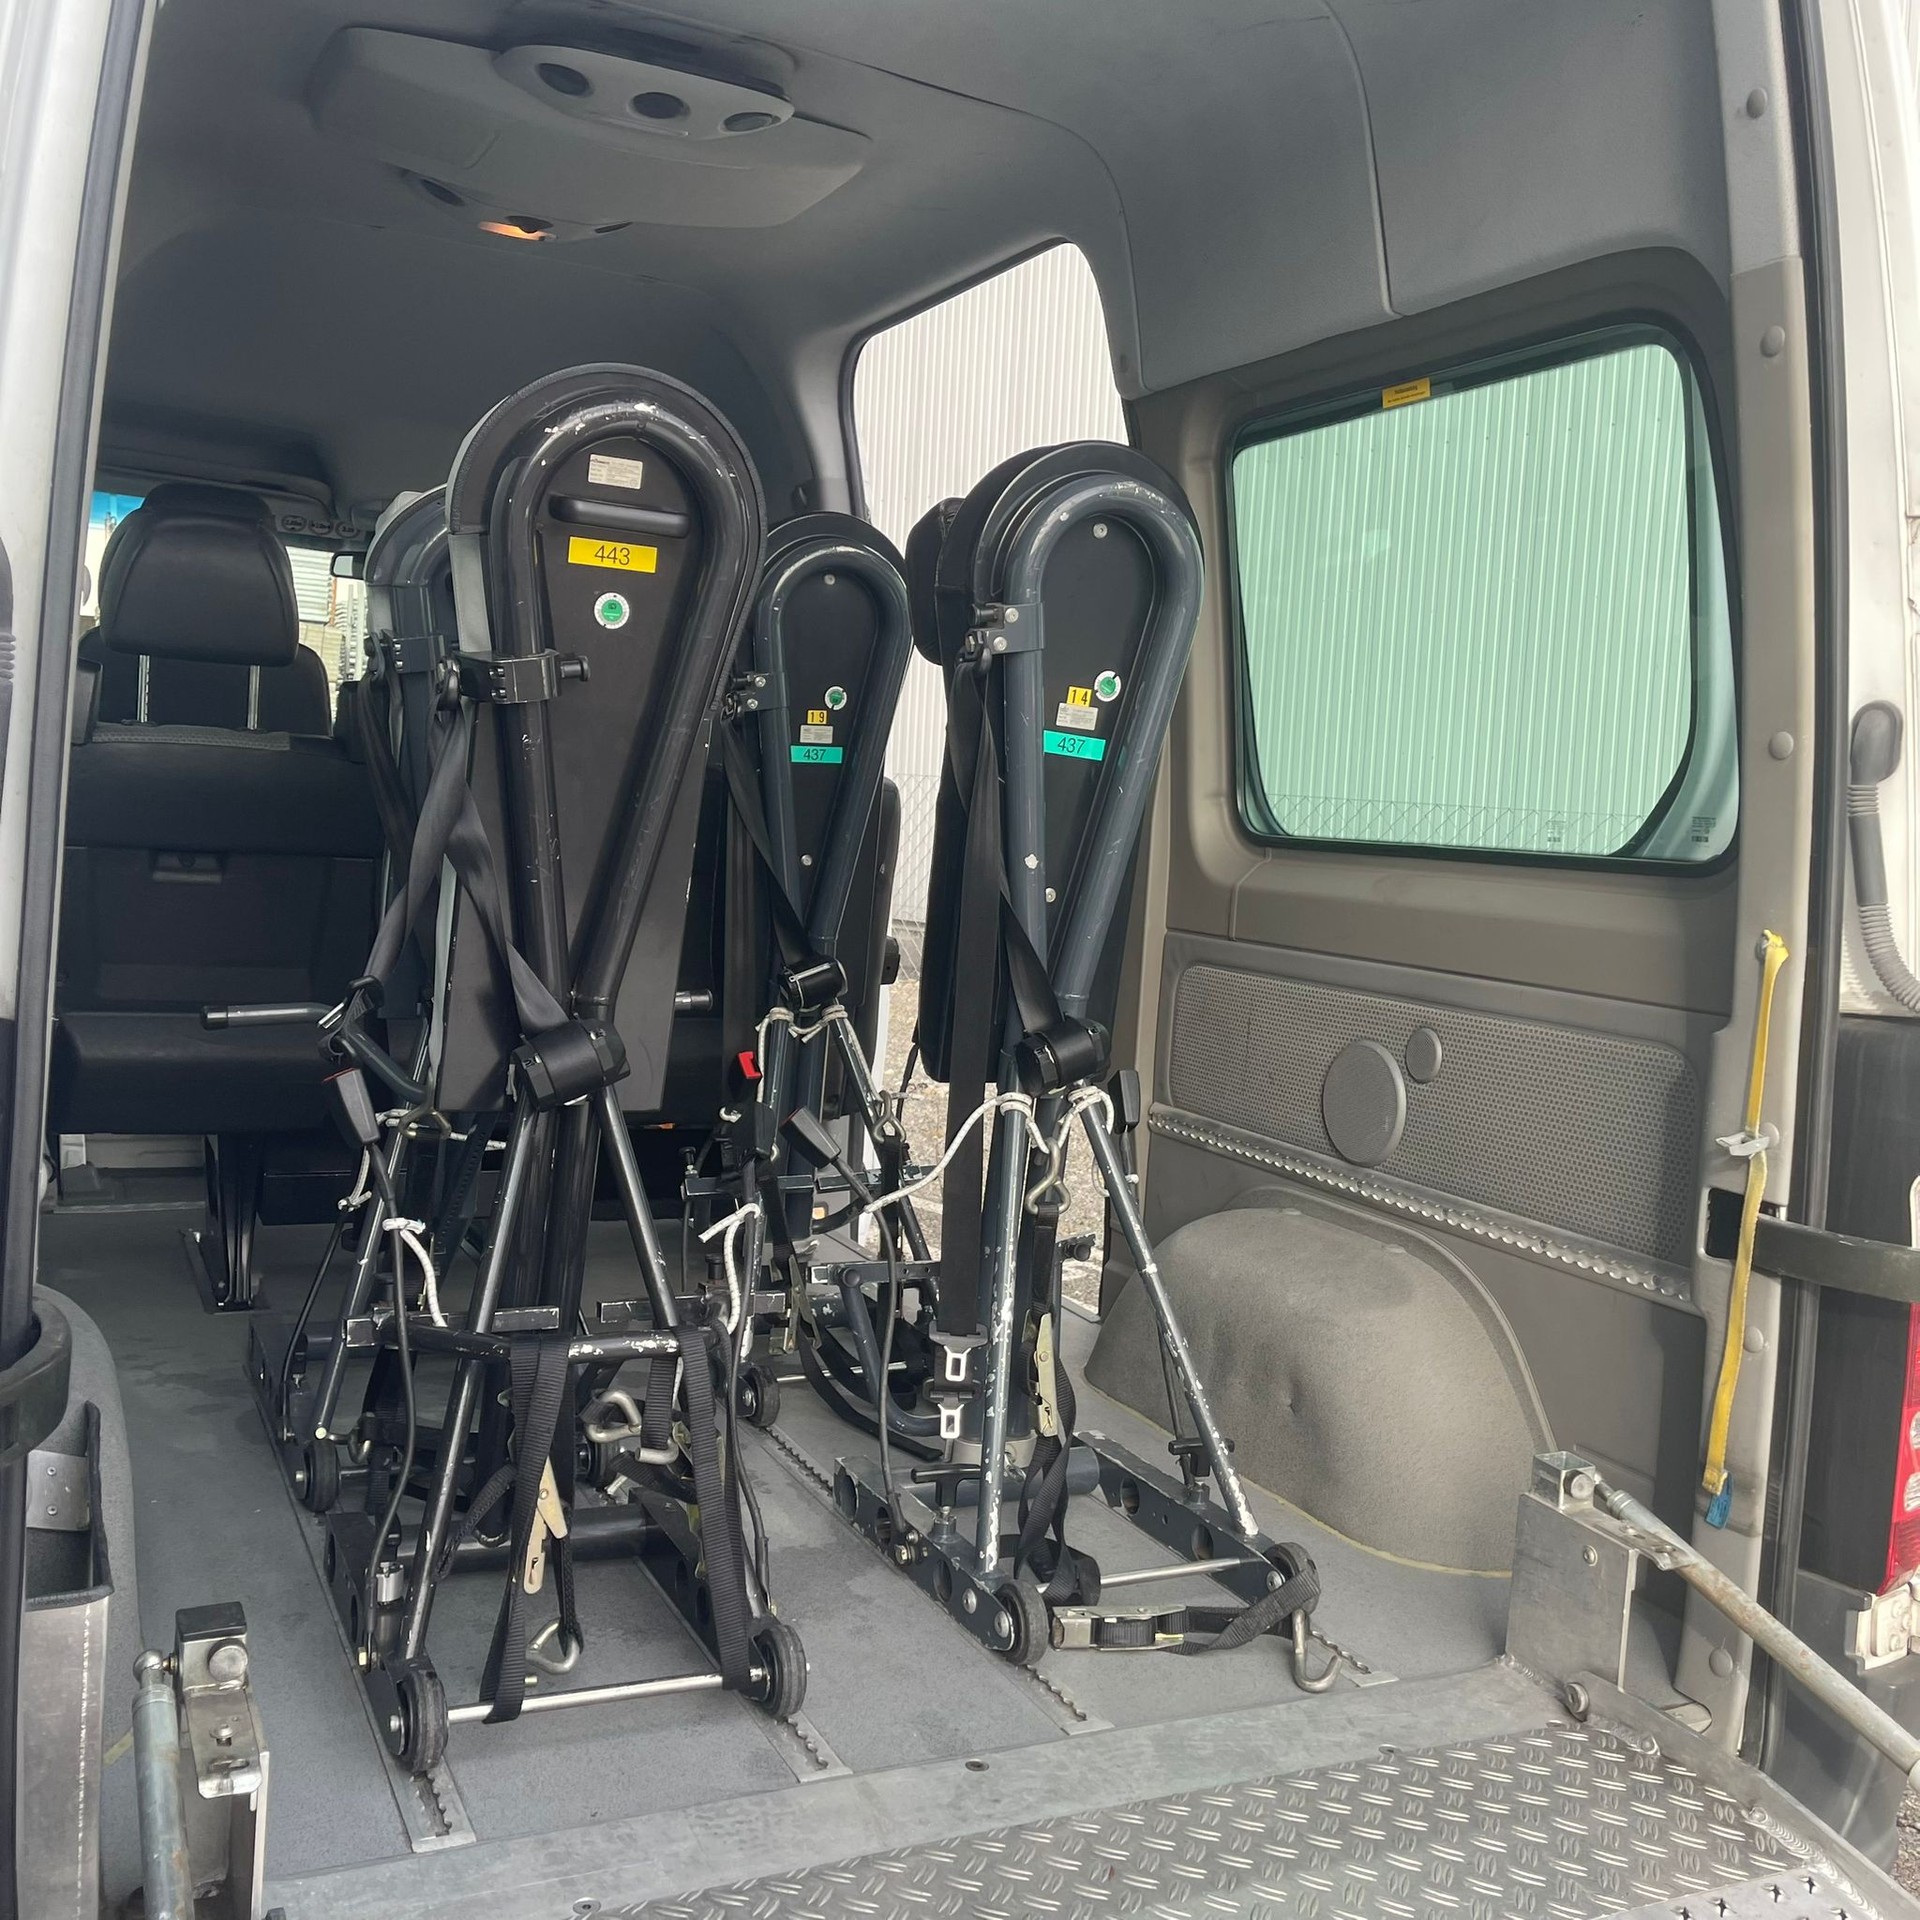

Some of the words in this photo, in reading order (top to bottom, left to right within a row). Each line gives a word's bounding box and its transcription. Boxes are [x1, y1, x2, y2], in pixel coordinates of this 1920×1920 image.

[594, 545, 630, 566] 443
[1057, 736, 1086, 754] 437
[803, 748, 827, 761] 437
